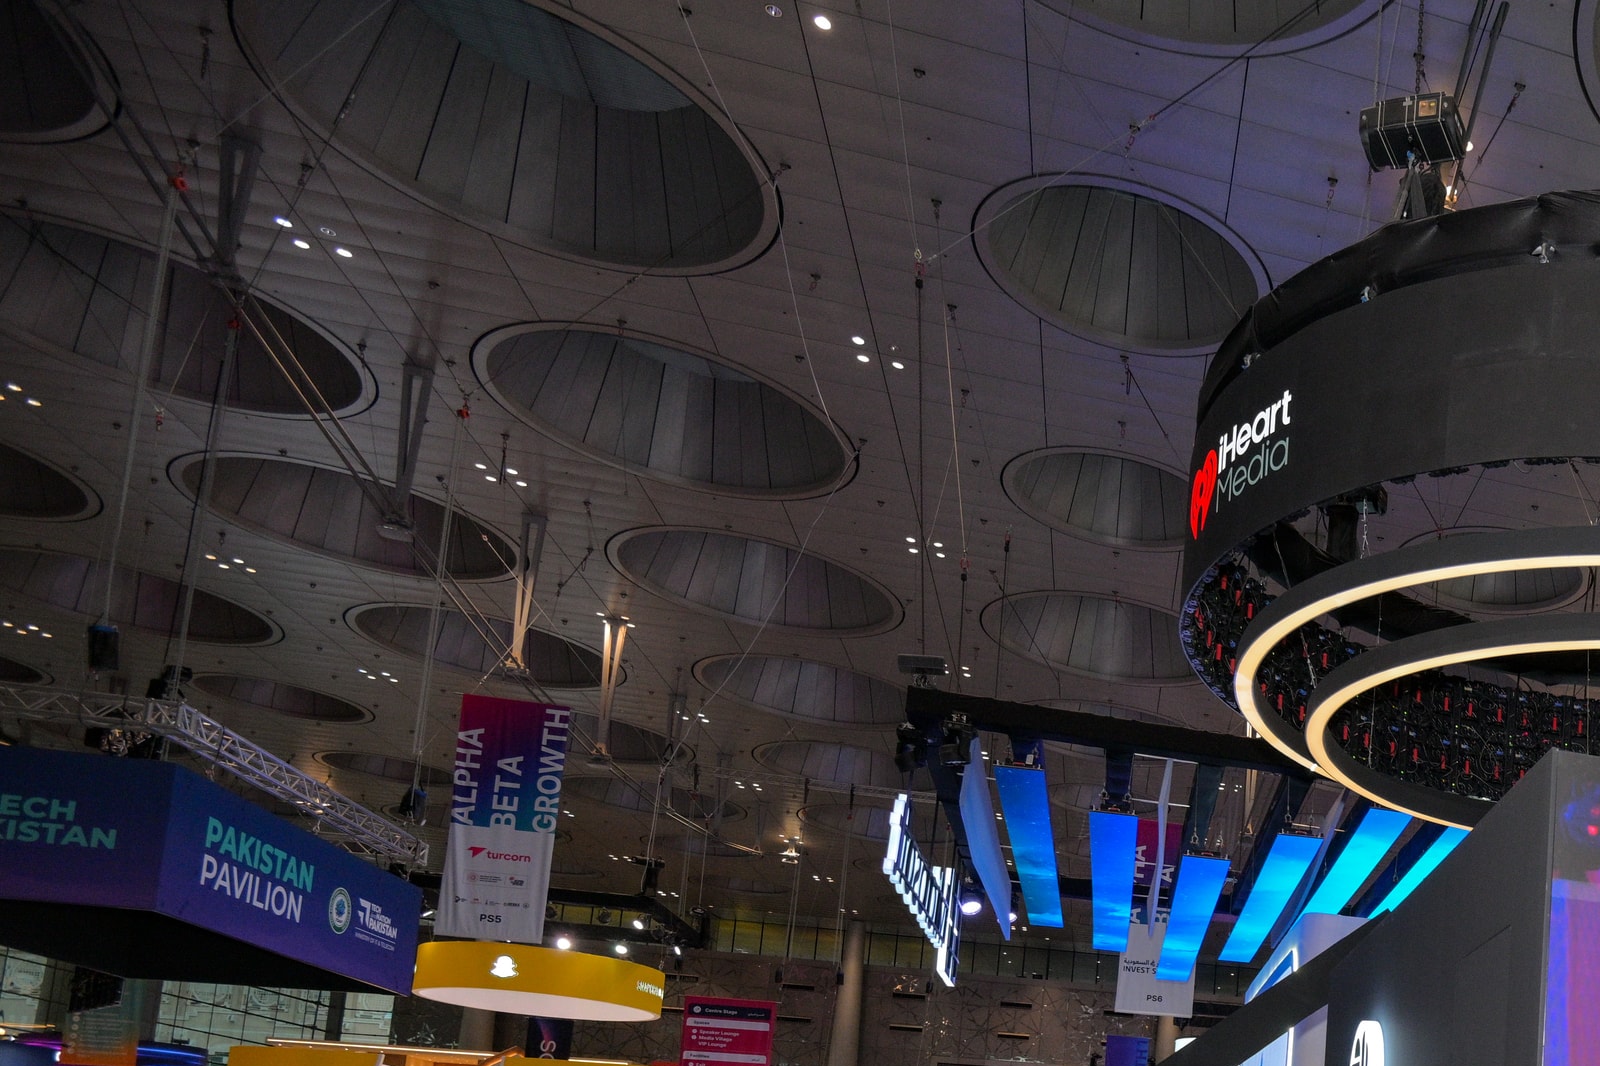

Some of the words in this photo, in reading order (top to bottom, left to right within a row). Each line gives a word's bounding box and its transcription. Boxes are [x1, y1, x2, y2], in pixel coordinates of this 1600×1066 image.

[1217, 389, 1292, 474] iHeart
[1215, 437, 1290, 513] Media
[450, 727, 485, 826] ALPHA
[489, 756, 524, 831] BETA
[532, 708, 571, 833] GROWTH
[200, 854, 303, 924] PAVILION
[205, 816, 315, 894] PAKISTAN
[487, 850, 531, 863] turcorn
[369, 917, 398, 939] PAKISTAN
[479, 913, 502, 923] PS5
[1123, 965, 1150, 974] INVEST
[1146, 994, 1163, 1003] PS6
